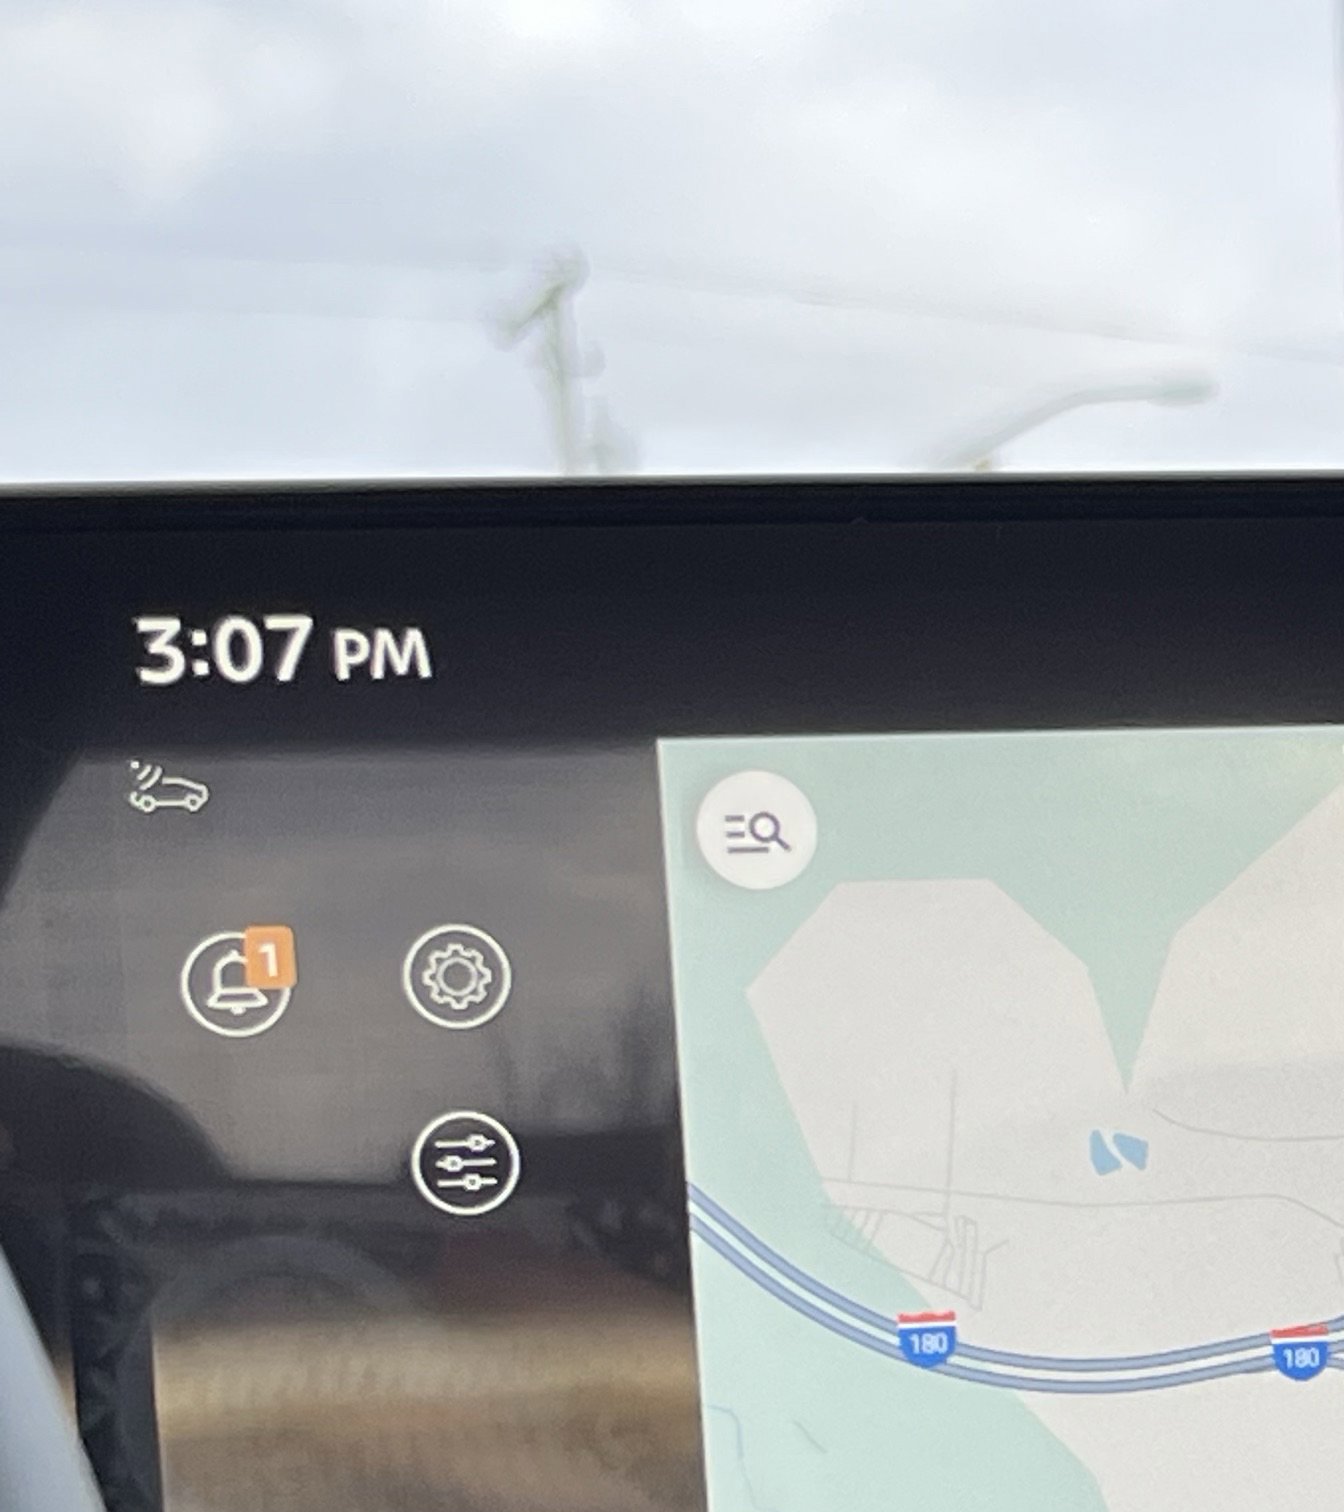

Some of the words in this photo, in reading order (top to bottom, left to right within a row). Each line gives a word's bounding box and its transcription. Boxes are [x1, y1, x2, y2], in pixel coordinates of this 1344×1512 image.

[134, 614, 314, 684] 3:07
[333, 629, 433, 681] PM
[259, 943, 279, 977] 1
[908, 1331, 949, 1354] 180
[1282, 1346, 1321, 1368] 180
